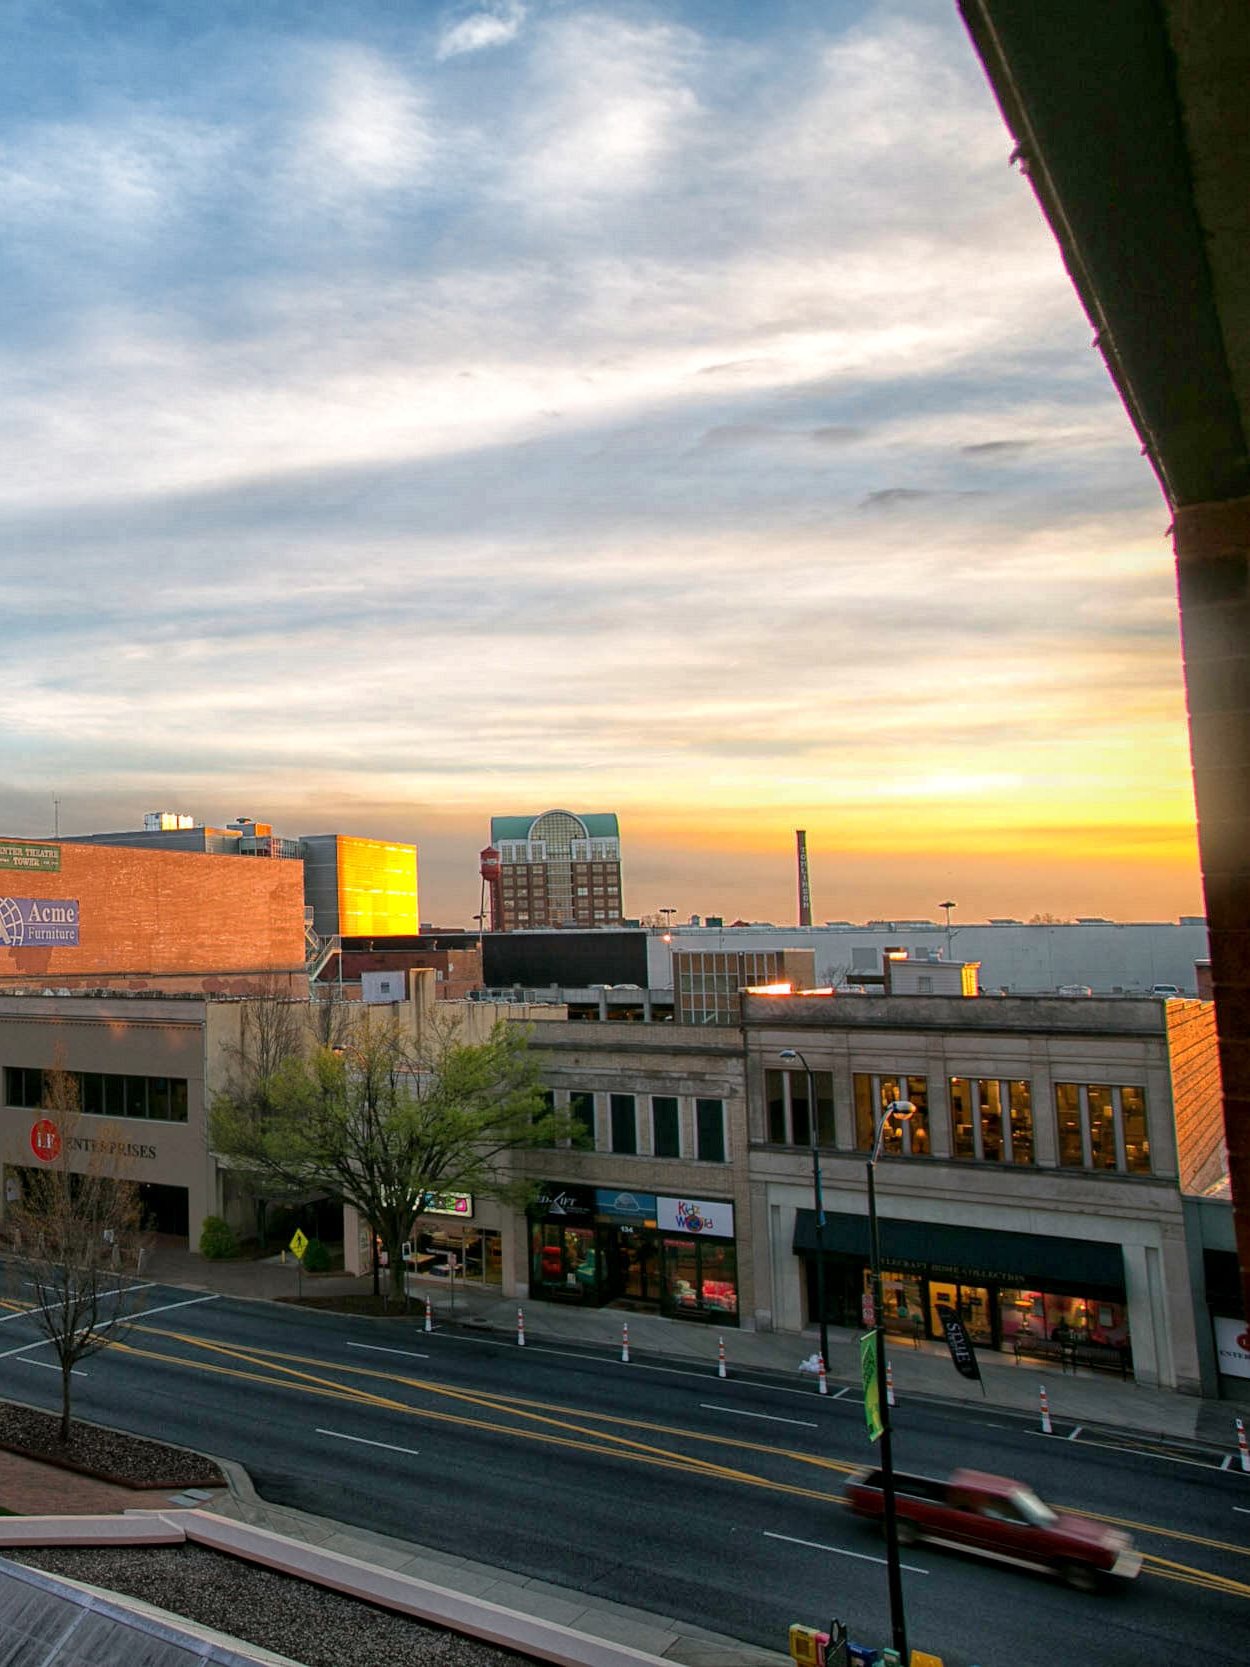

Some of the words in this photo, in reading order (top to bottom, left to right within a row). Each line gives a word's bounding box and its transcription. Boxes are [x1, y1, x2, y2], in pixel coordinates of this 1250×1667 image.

[12, 857, 40, 867] TOWER
[25, 848, 59, 859] THEATRE
[800, 847, 810, 909] TOMLINSON
[29, 902, 75, 923] Acme
[28, 927, 76, 940] Furniture
[67, 1137, 157, 1159] ENTERPRISES
[678, 1201, 701, 1216] Kidz
[946, 1322, 971, 1363] STYLE
